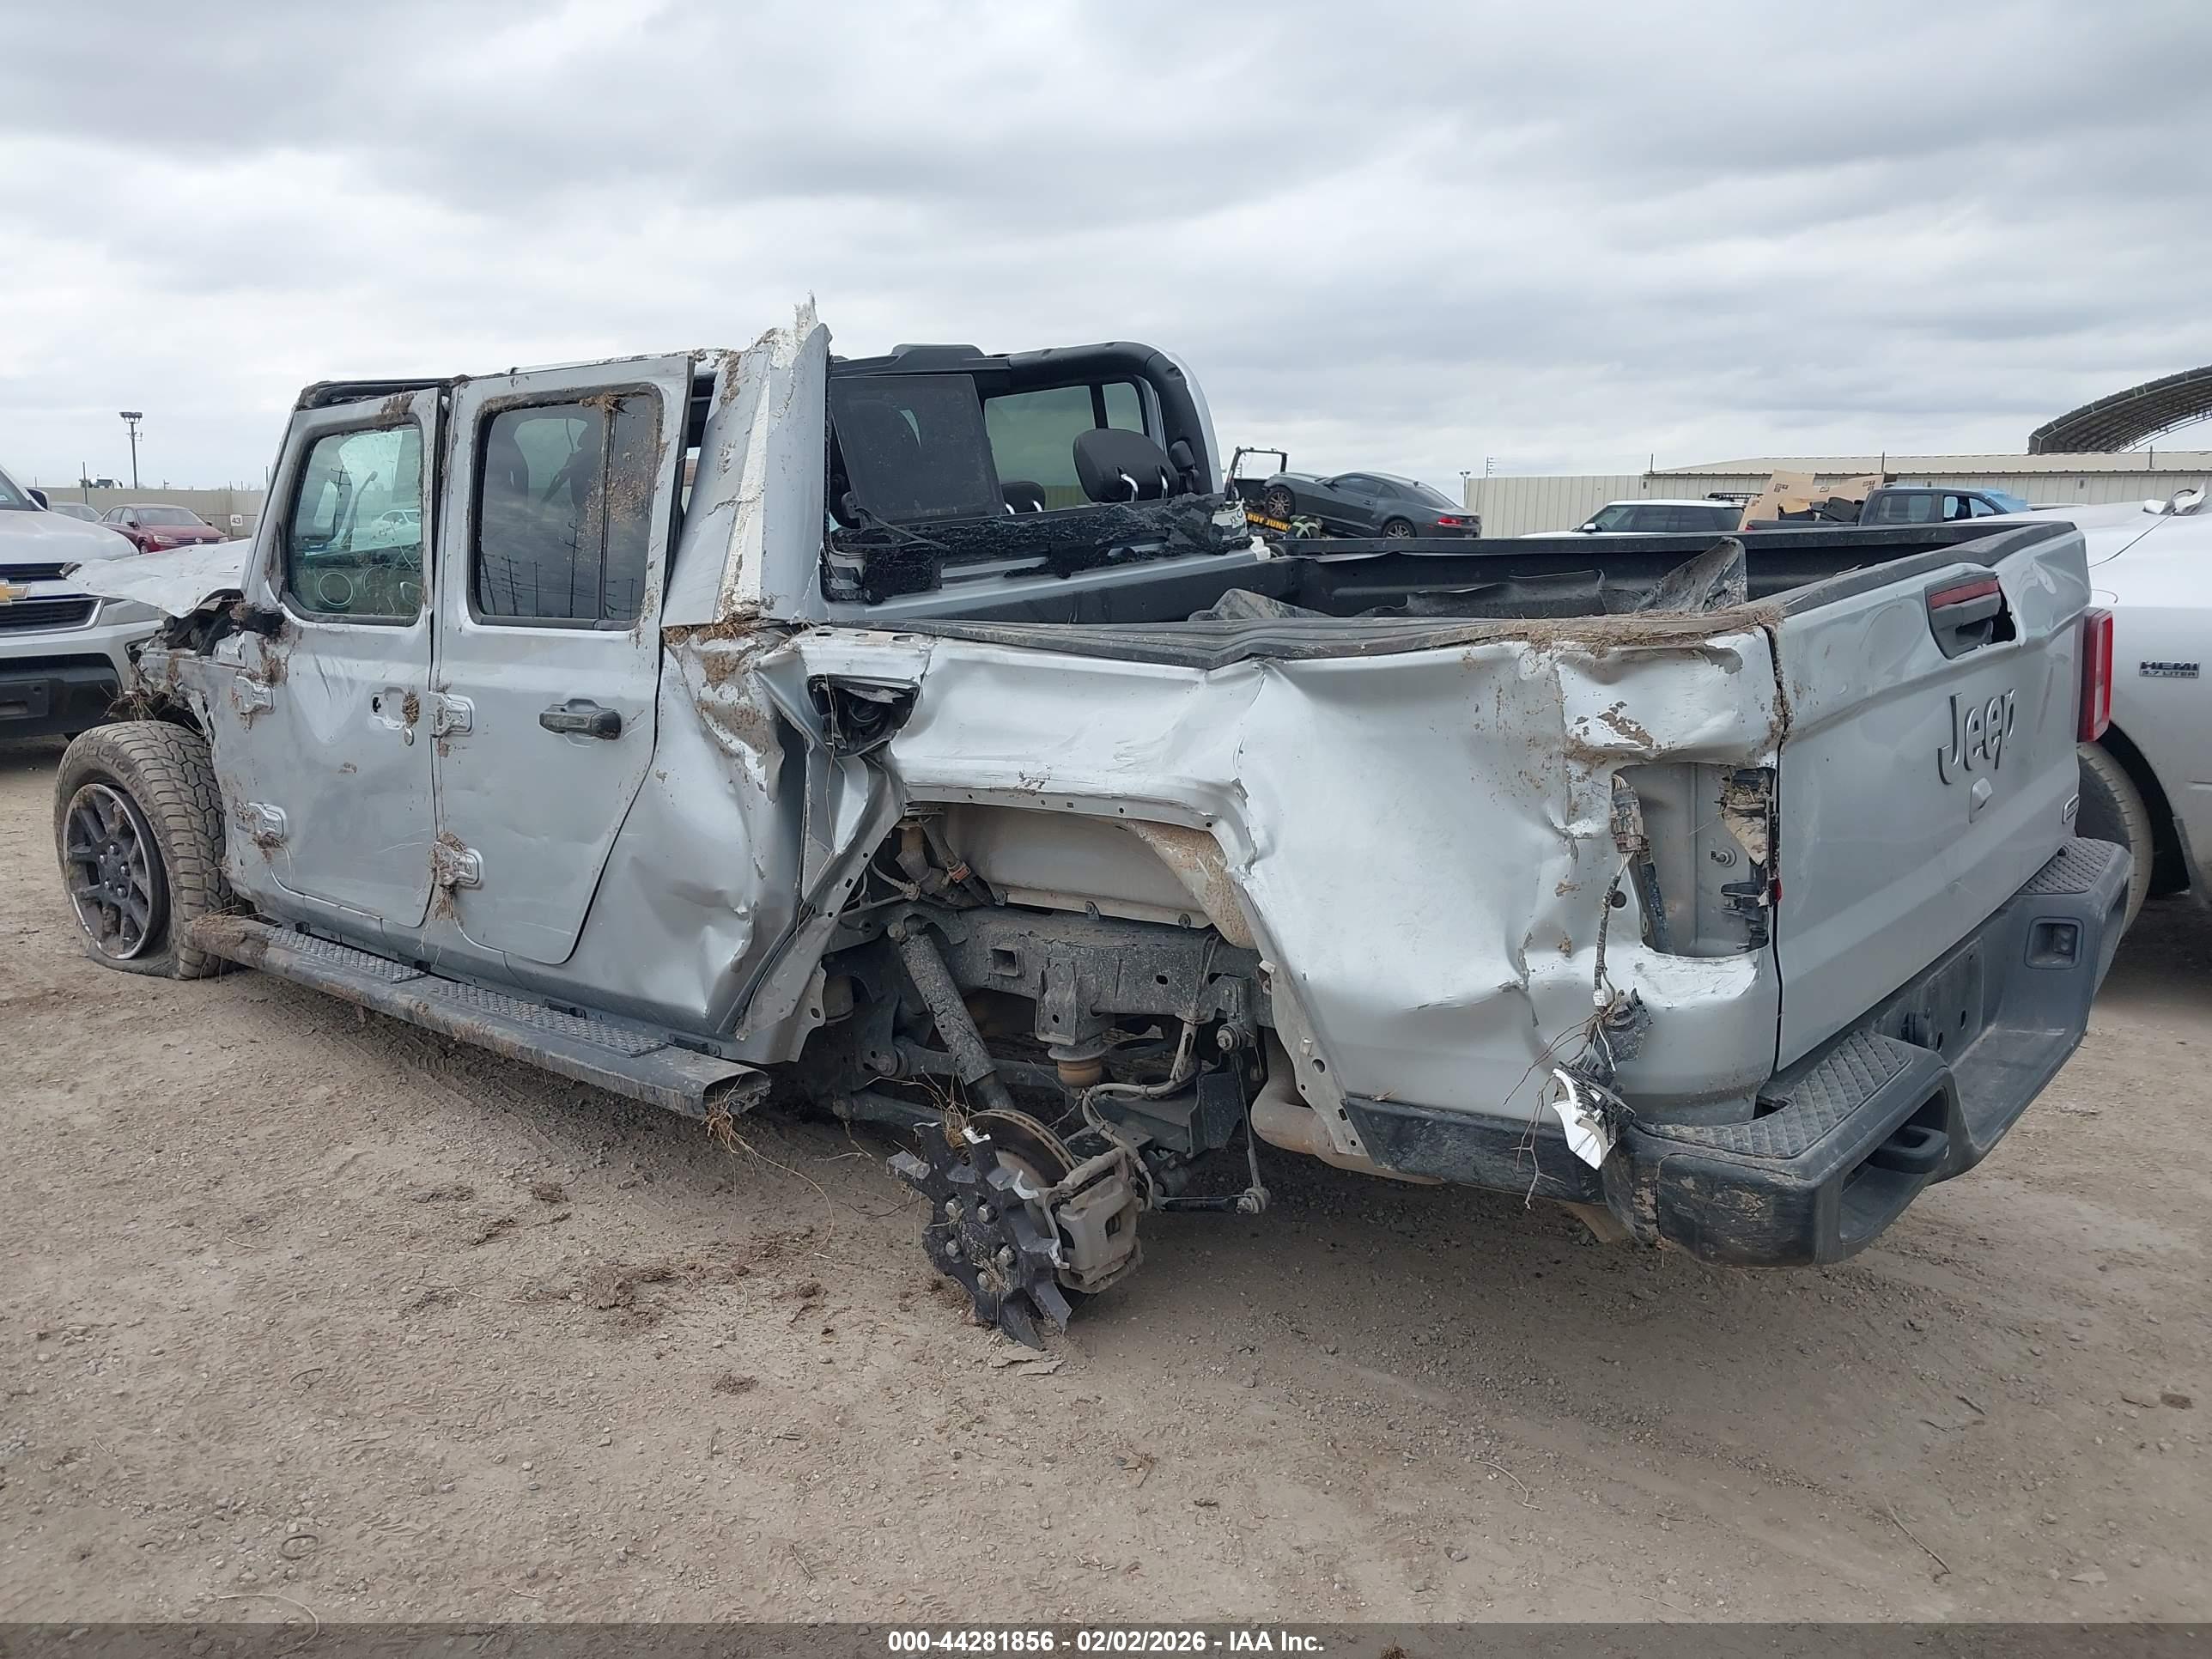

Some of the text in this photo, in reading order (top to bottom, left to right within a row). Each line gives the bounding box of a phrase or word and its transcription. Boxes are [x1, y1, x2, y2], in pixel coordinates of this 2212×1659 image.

[1247, 513, 1264, 524] BUY
[2140, 660, 2199, 671] HEMI
[1937, 689, 2015, 785] Jeep
